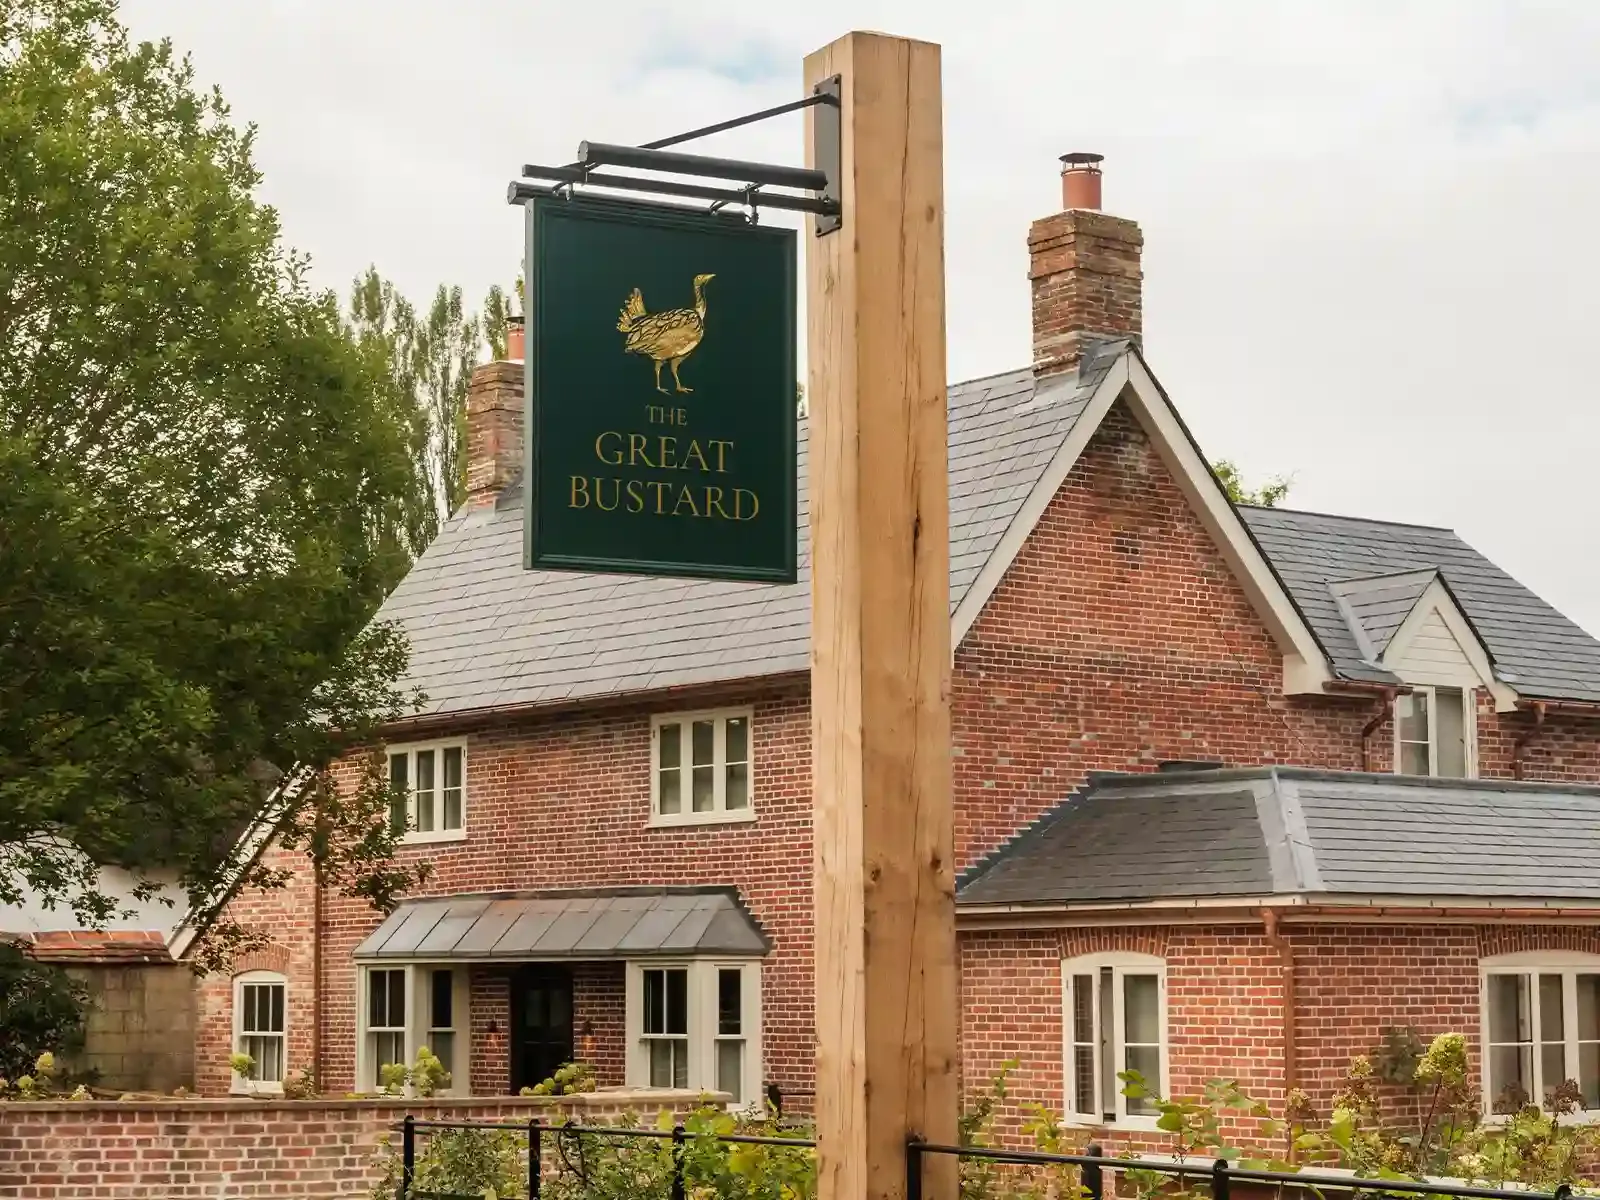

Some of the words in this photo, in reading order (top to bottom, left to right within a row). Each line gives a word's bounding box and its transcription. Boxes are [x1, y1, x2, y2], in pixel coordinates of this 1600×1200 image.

[646, 404, 688, 426] THE
[594, 431, 735, 473] GREAT
[567, 475, 761, 521] BUSTARD
